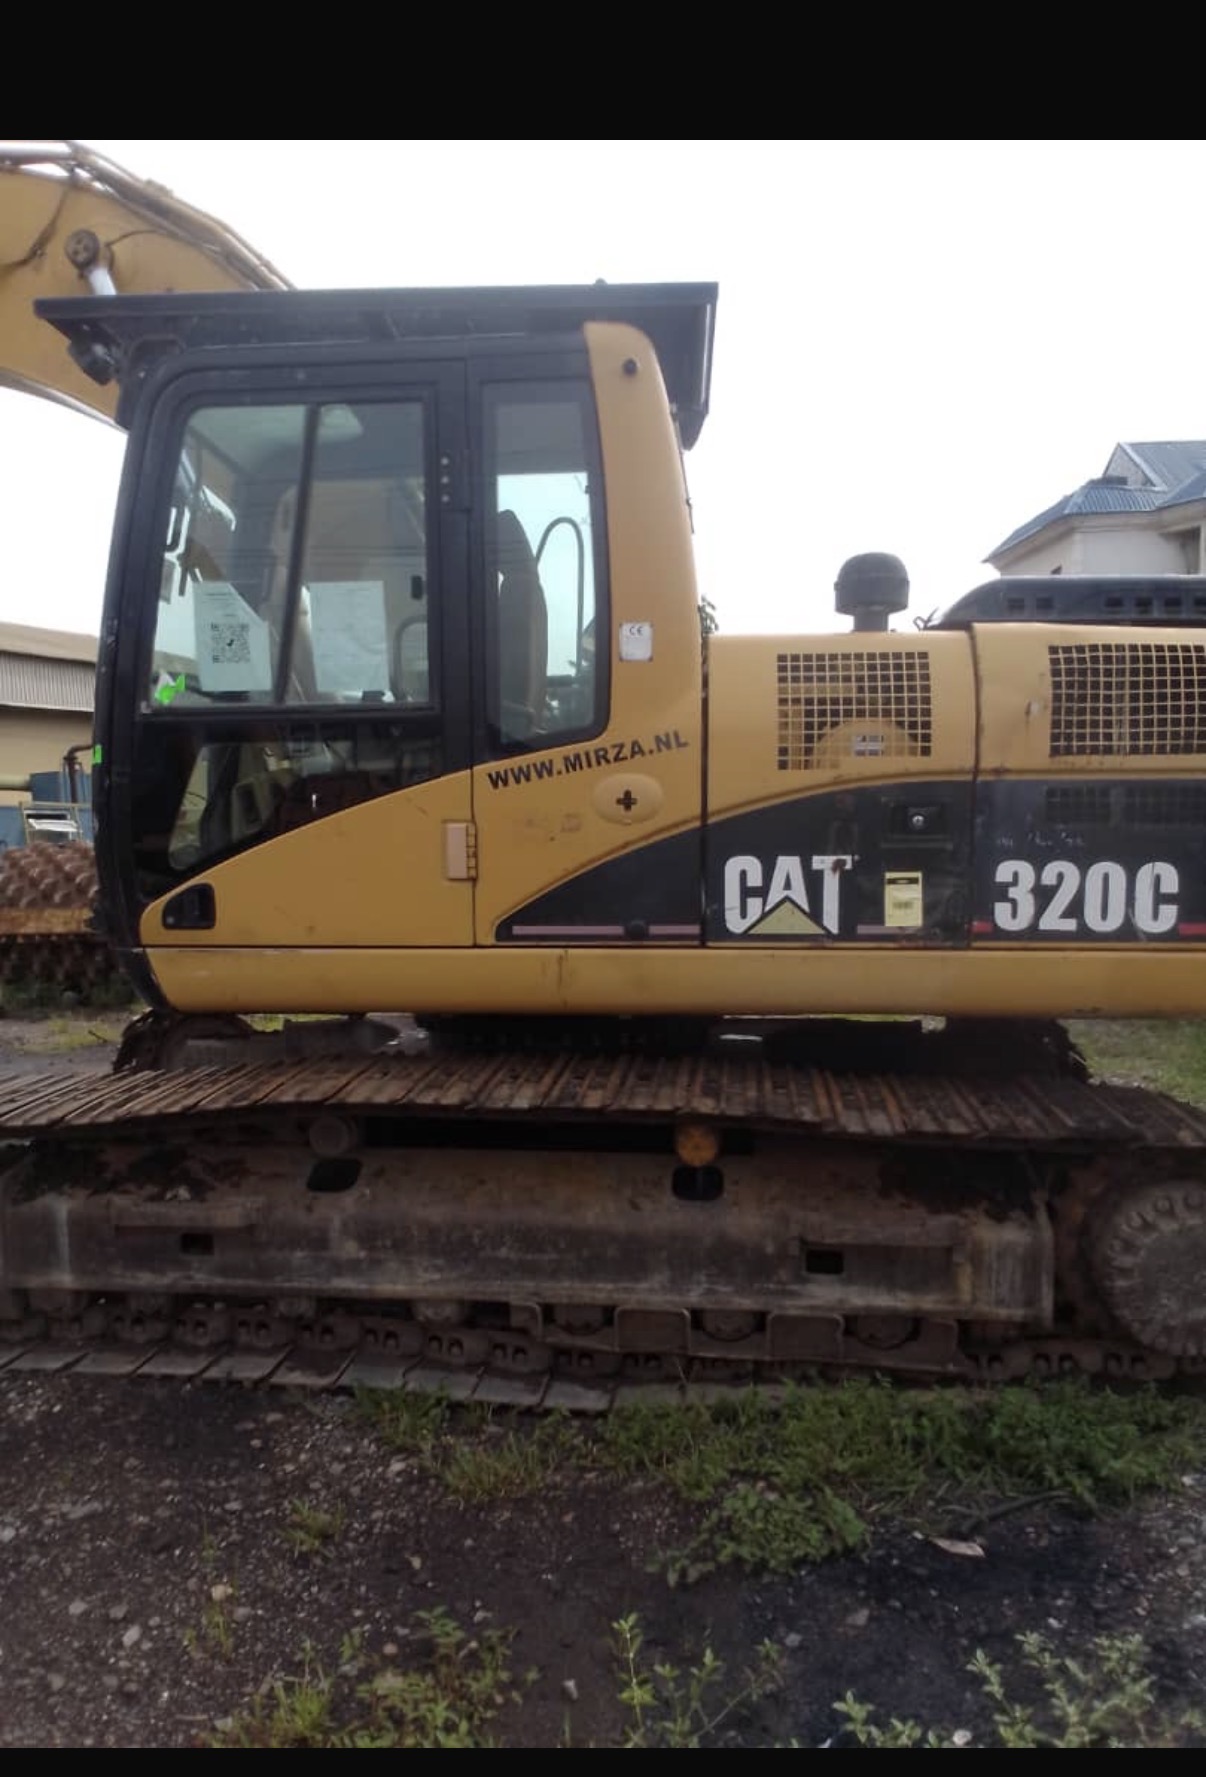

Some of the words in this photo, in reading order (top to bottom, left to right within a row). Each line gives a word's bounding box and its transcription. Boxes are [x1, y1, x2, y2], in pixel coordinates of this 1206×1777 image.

[487, 730, 689, 790] WWW.MIRZA.NL
[724, 855, 852, 934] CAT
[994, 859, 1179, 933] 320C
